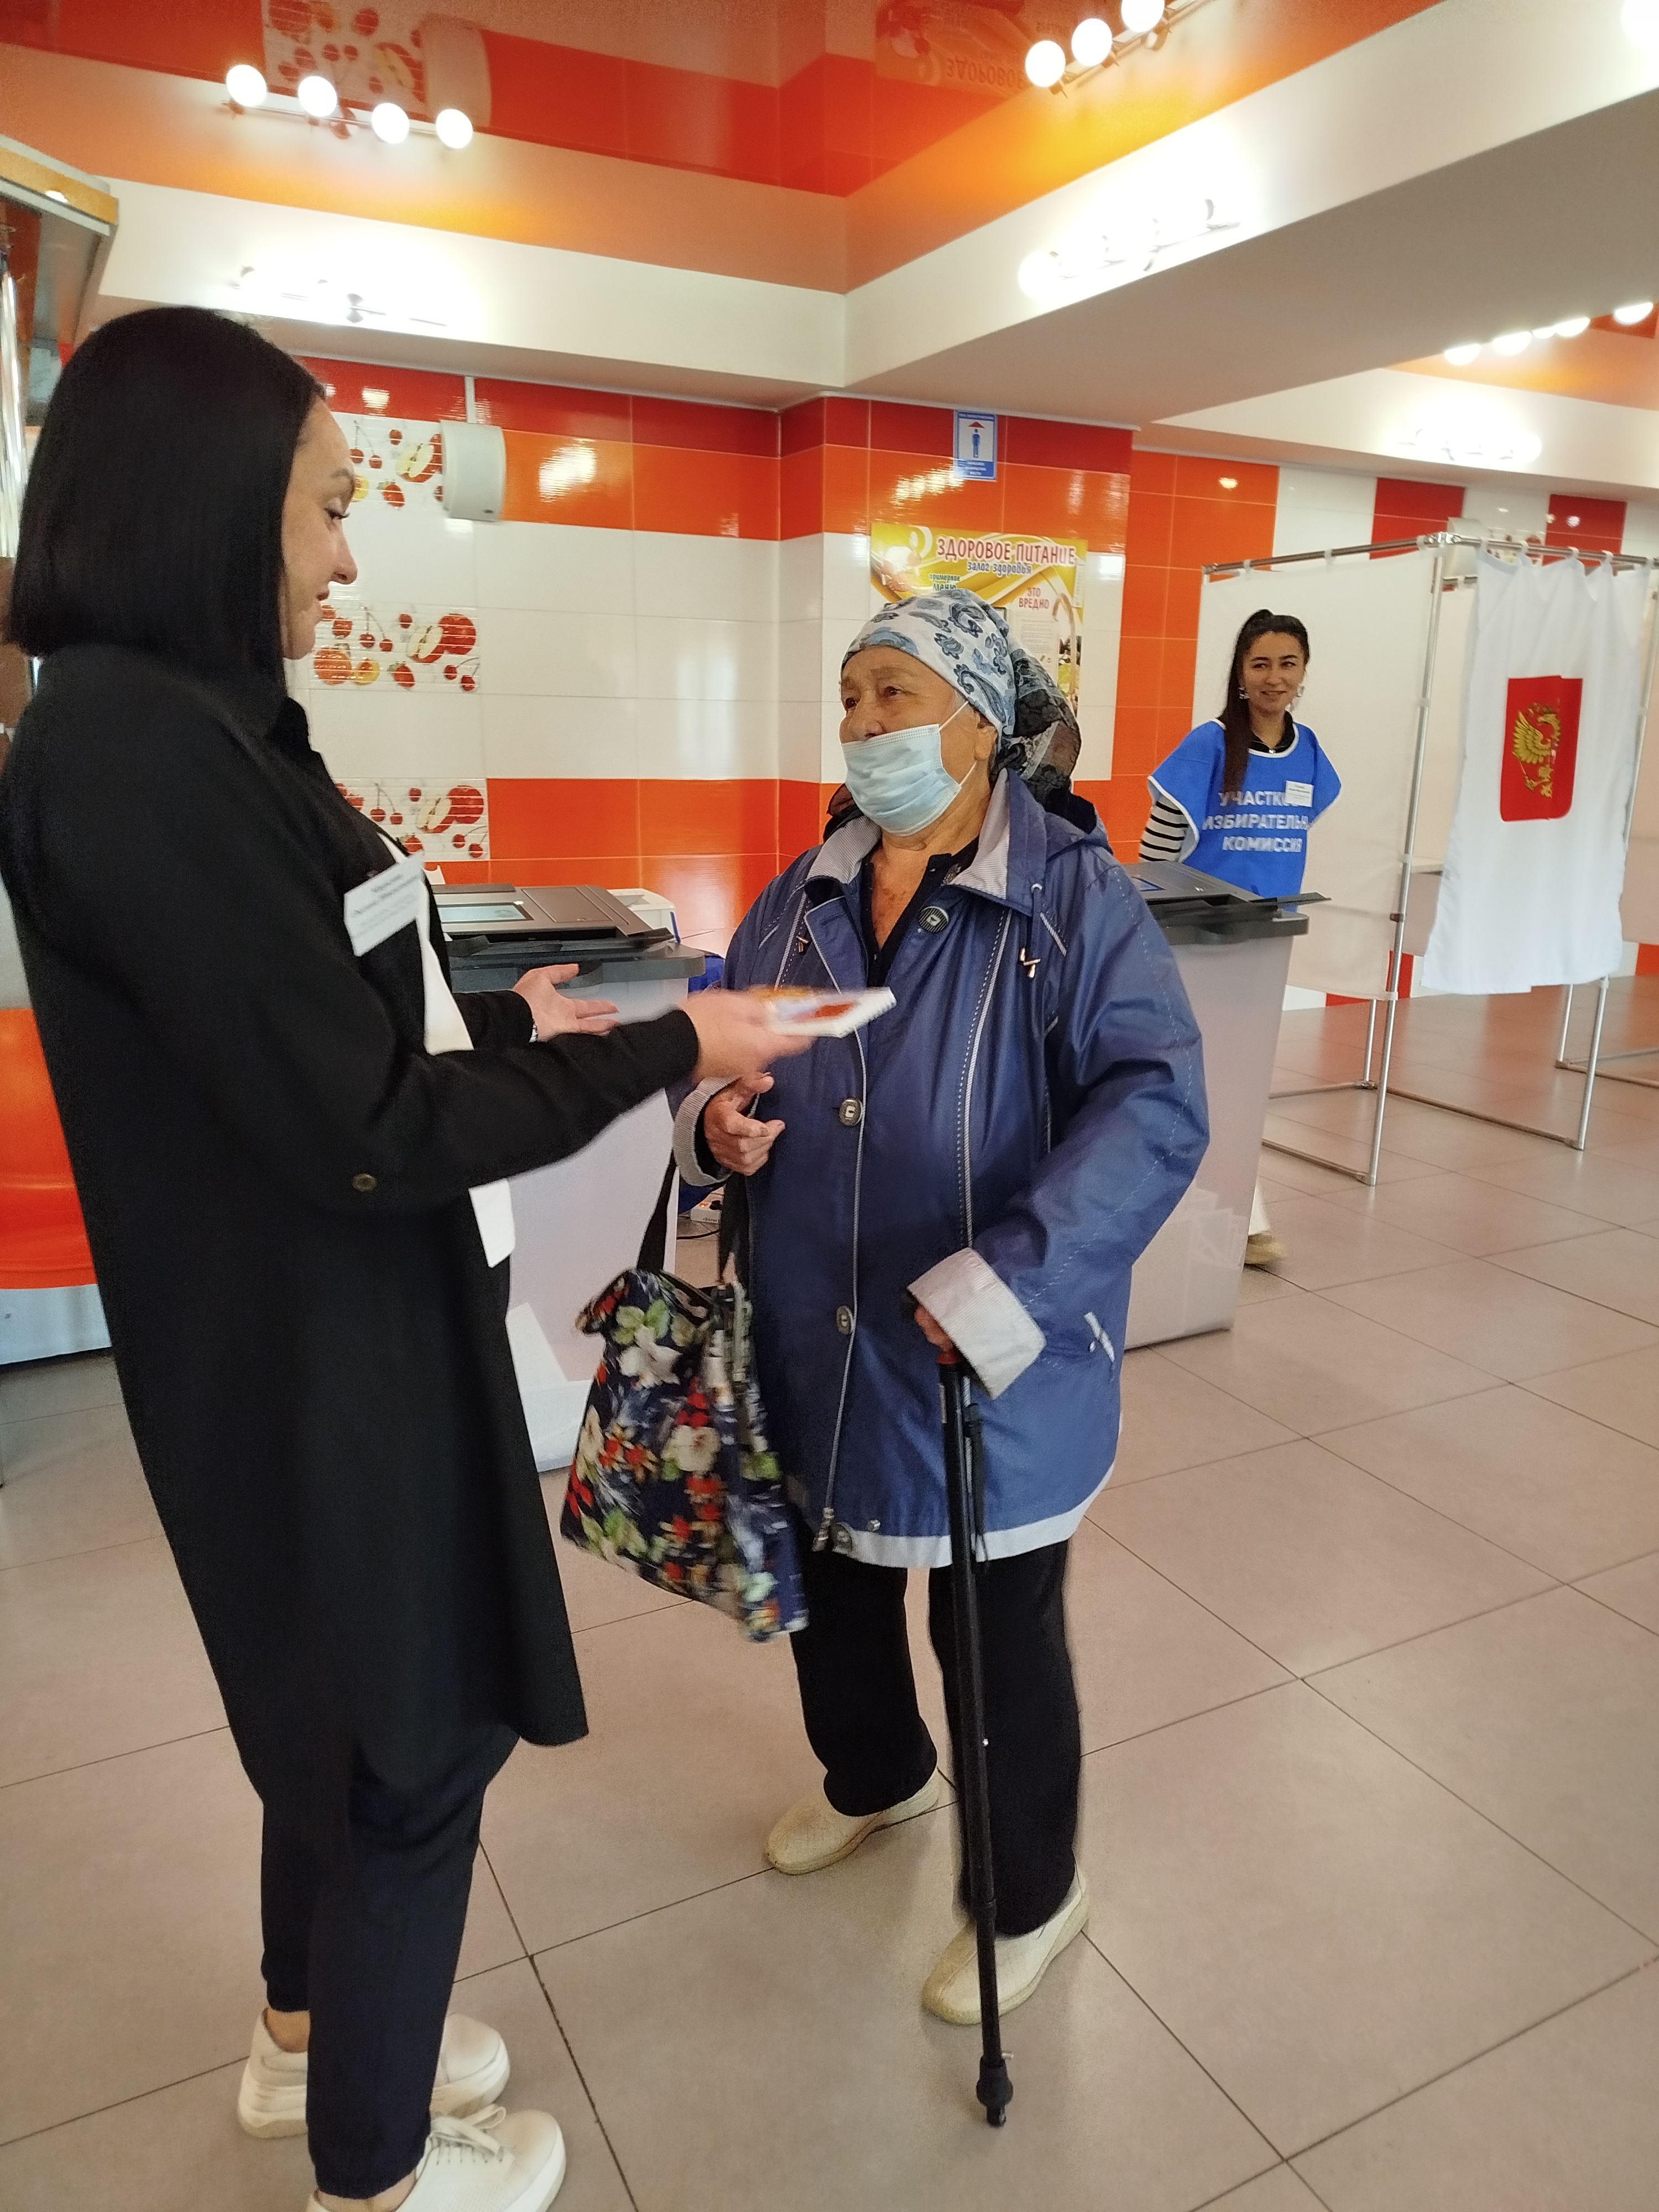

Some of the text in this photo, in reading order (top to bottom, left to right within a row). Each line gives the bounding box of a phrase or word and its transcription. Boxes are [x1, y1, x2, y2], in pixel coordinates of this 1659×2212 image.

[937, 539, 1075, 564] ЗДОРОВОЕ ПИТАНИЕ
[967, 561, 1031, 576] залог здоровья
[929, 574, 959, 583] примерное
[1027, 587, 1041, 597] ЭТО
[1019, 598, 1050, 609] ВРЕДНО
[1218, 791, 1300, 806] УЧАСТК
